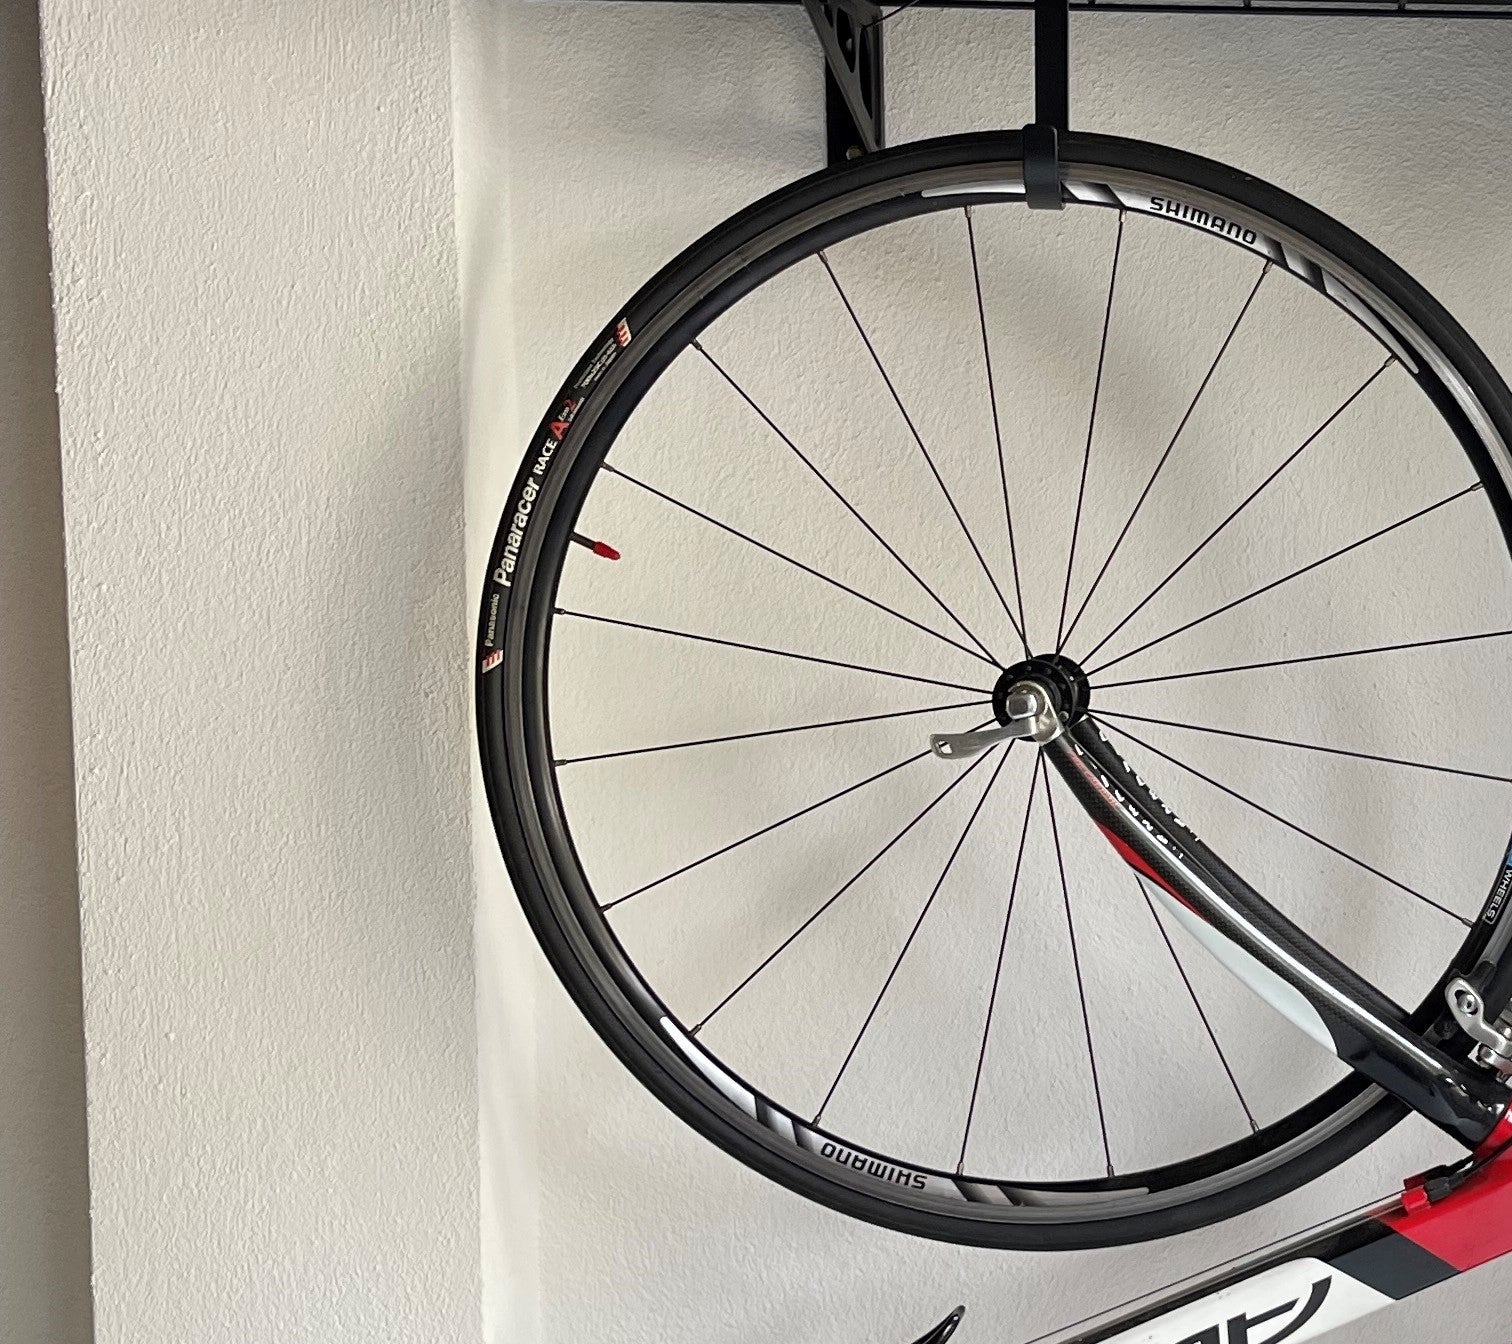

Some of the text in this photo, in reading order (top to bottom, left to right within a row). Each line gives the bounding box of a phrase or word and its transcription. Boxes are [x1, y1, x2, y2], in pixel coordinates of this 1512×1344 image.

[1150, 196, 1257, 245] SHIMANO
[493, 477, 540, 588] Panaracer
[533, 439, 559, 476] RACE
[820, 1142, 928, 1190] SHIMANO
